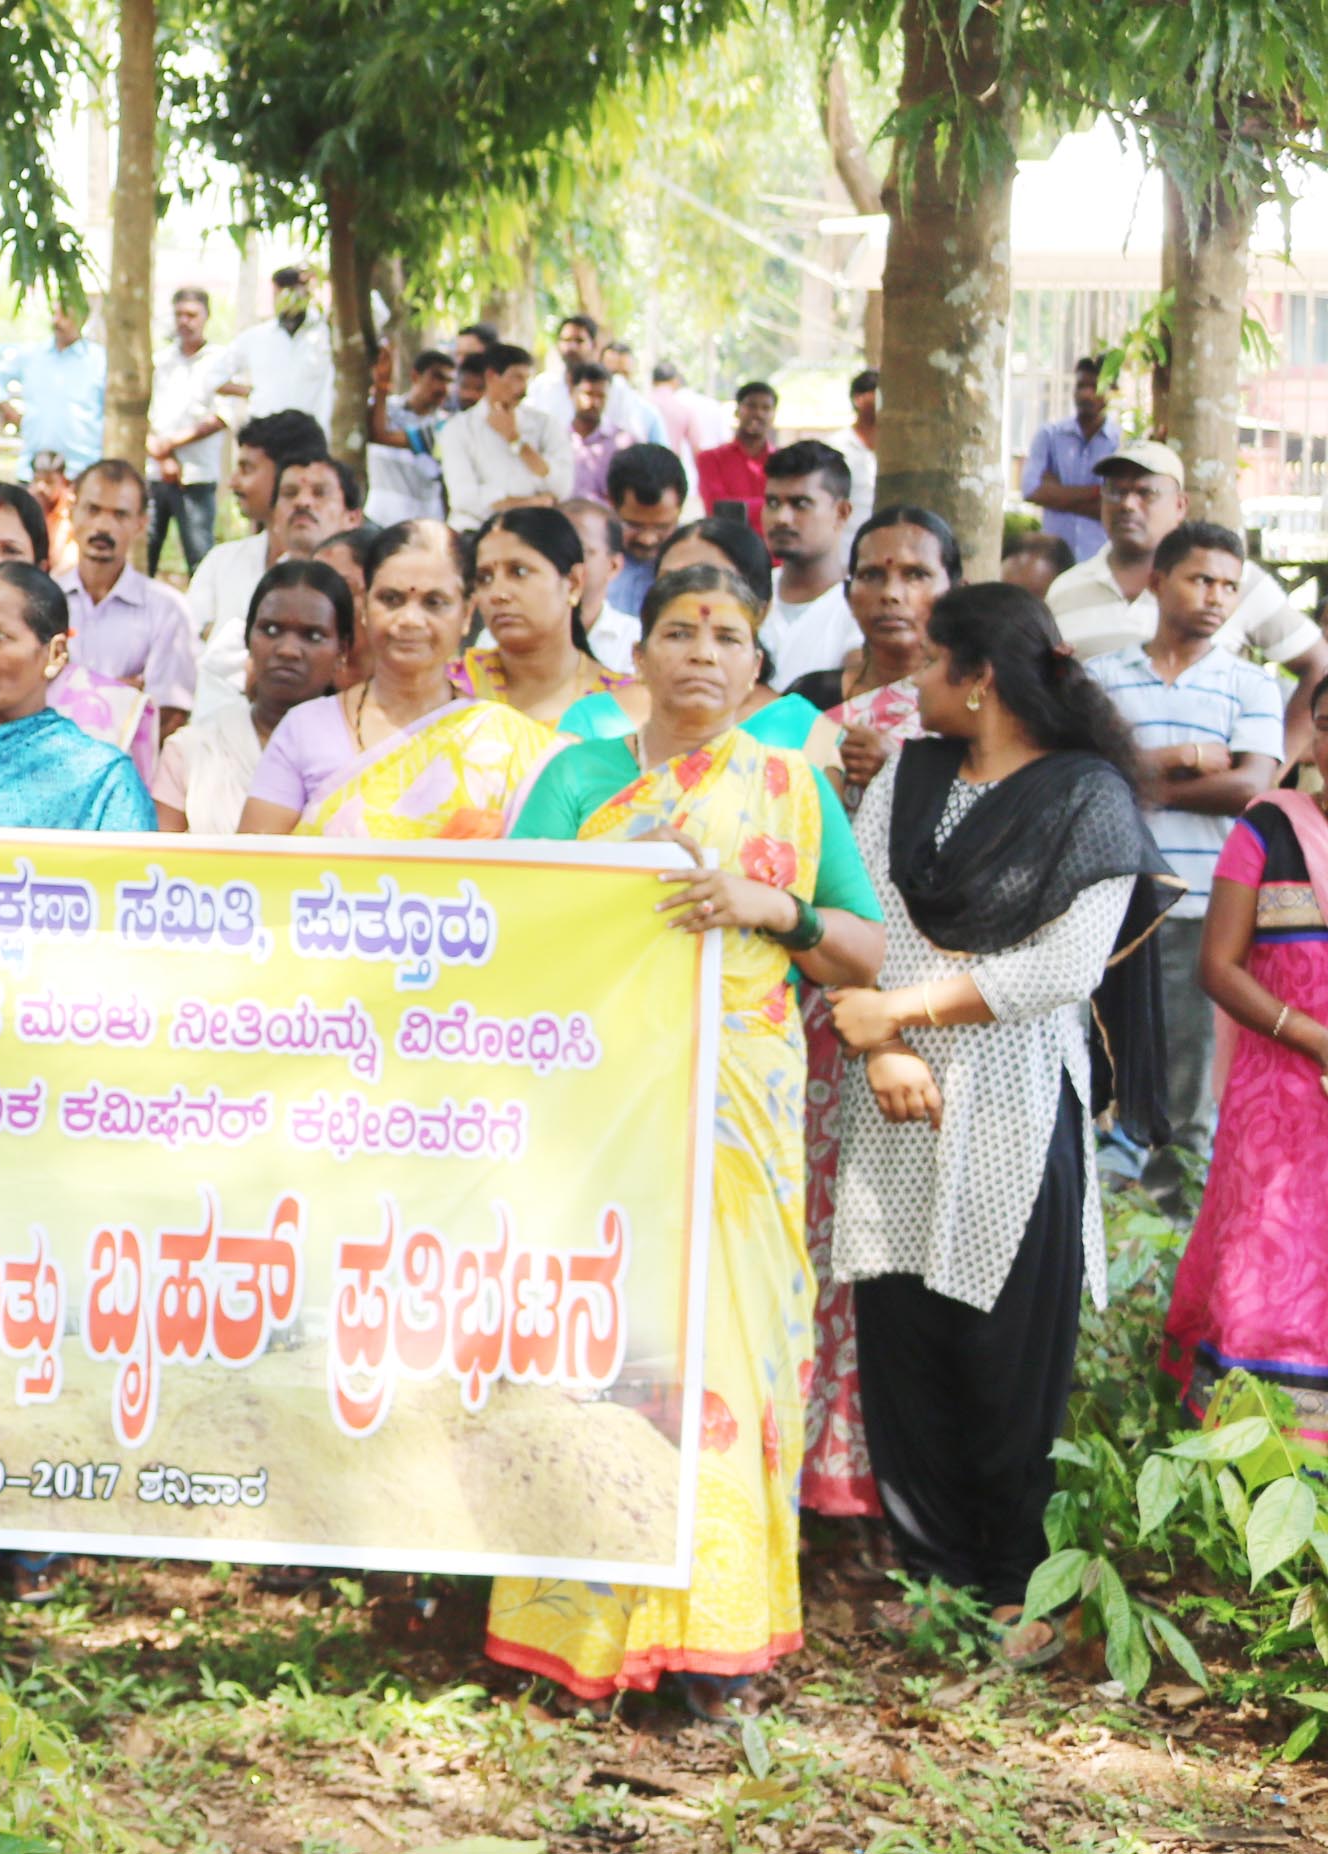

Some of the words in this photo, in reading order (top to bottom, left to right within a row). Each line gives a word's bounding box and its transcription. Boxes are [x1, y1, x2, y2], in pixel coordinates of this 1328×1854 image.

[121, 869, 266, 955] ಸಮಿತಿ,
[295, 877, 489, 983] ಪುತ್ತೂರು
[20, 989, 150, 1041] ಮರಳು
[174, 999, 375, 1073] ನೀತಿಯನ್ನು
[400, 1006, 595, 1068] ವಿರೋಧಿಸಿ
[63, 1087, 266, 1144] ಕಮಿಷನರ್
[88, 1186, 300, 1441] ಬೃಹತ್
[334, 1197, 624, 1431] ಪ್ರತಿಭಟನೆ
[137, 1466, 268, 1508] ಶನಿವಾರ
